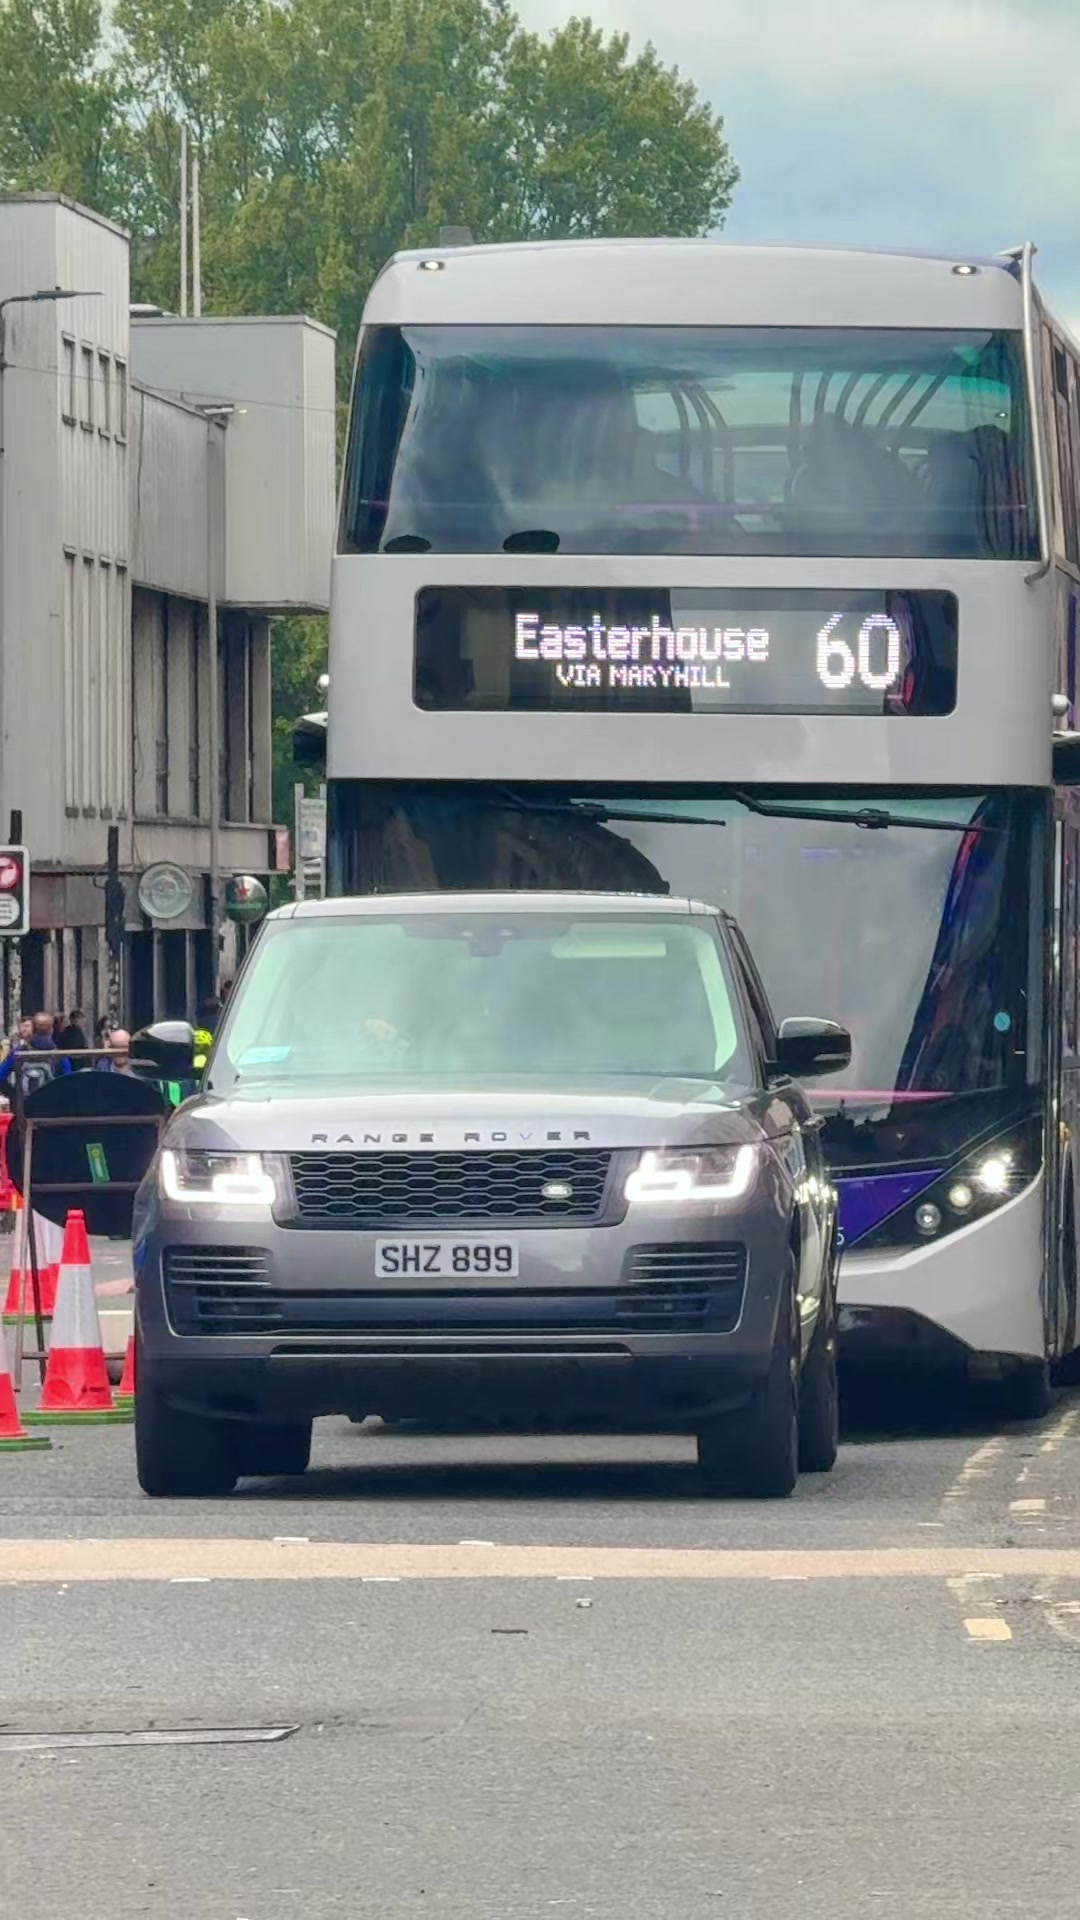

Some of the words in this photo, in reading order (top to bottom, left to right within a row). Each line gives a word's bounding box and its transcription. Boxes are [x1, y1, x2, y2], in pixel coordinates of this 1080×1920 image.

[514, 612, 769, 660] Easterhouse
[815, 613, 901, 688] 60
[555, 665, 600, 687] VIA
[609, 665, 731, 688] MARYHILL
[311, 1133, 435, 1144] RANGE
[463, 1131, 592, 1143] ROVER
[381, 1246, 441, 1273] SHZ
[452, 1245, 512, 1273] 899
